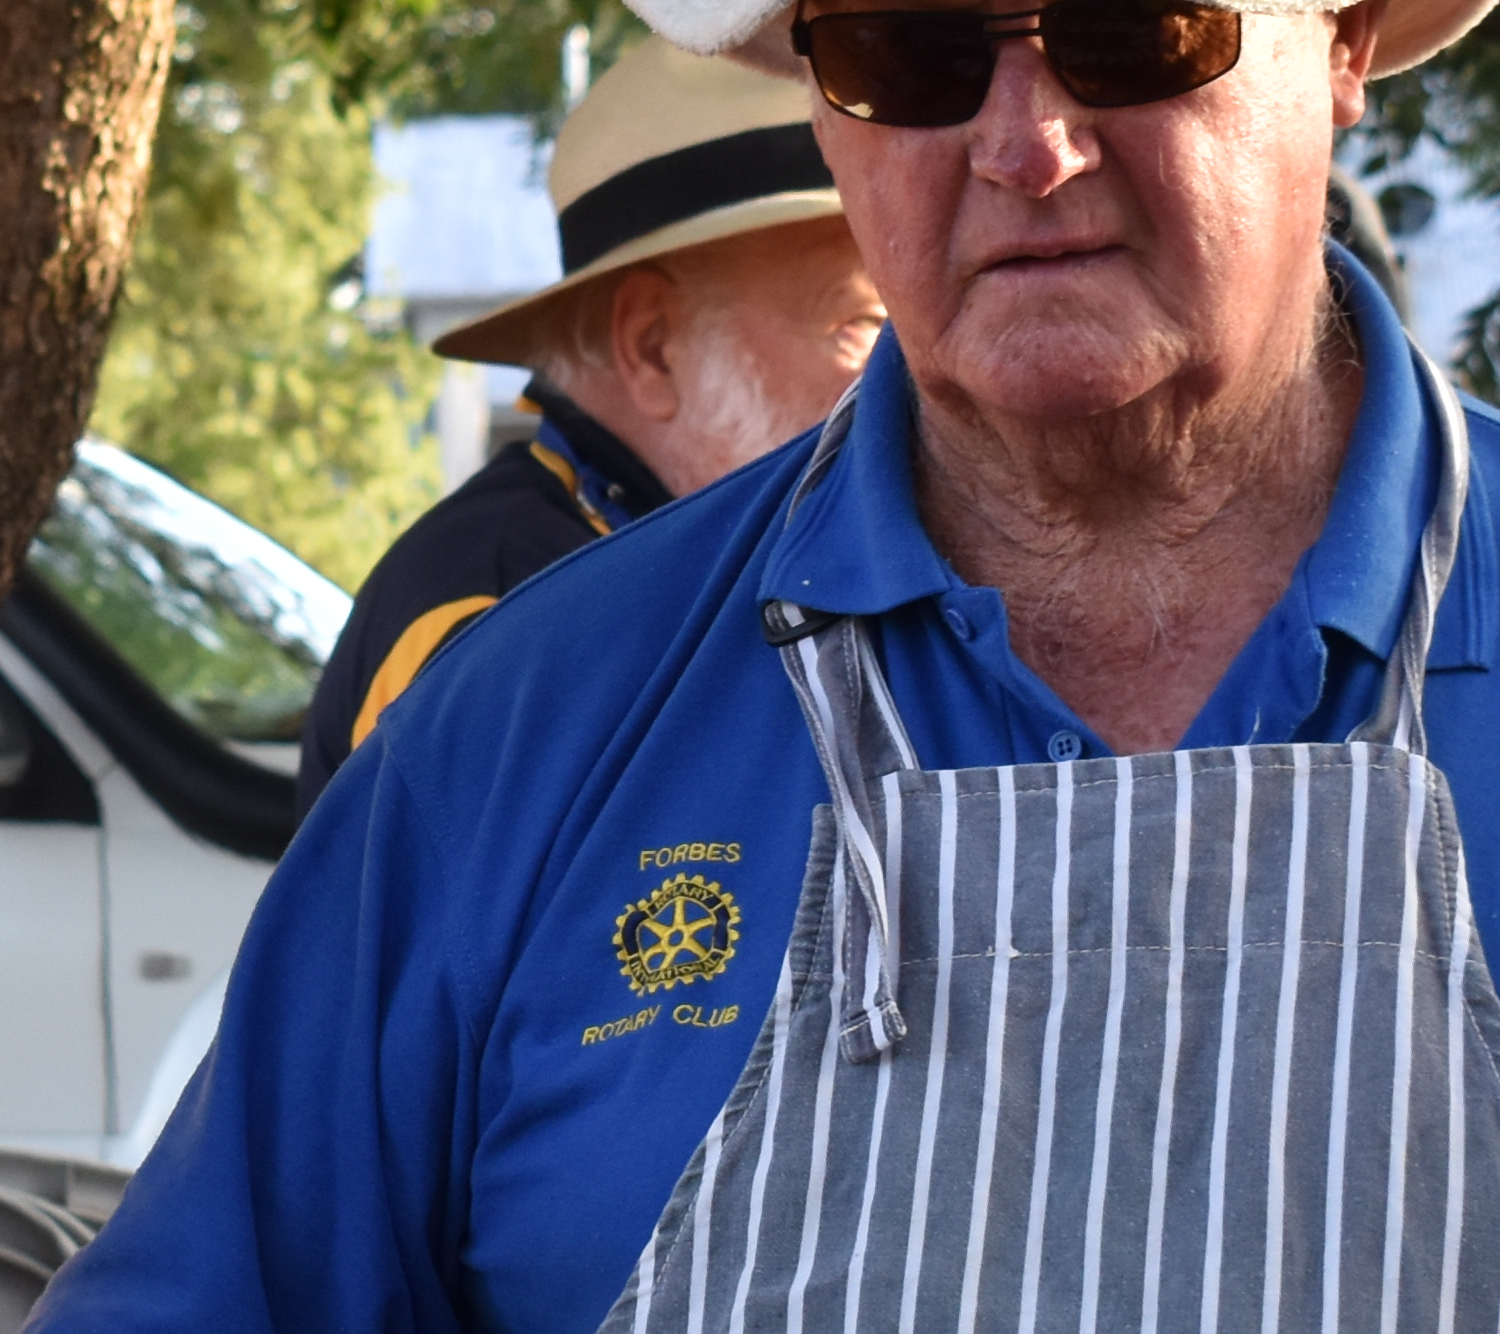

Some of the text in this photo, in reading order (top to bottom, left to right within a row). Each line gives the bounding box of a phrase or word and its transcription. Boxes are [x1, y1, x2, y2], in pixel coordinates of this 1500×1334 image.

[639, 842, 741, 871] FORBES
[581, 1004, 740, 1046] ROTARY CLUB
